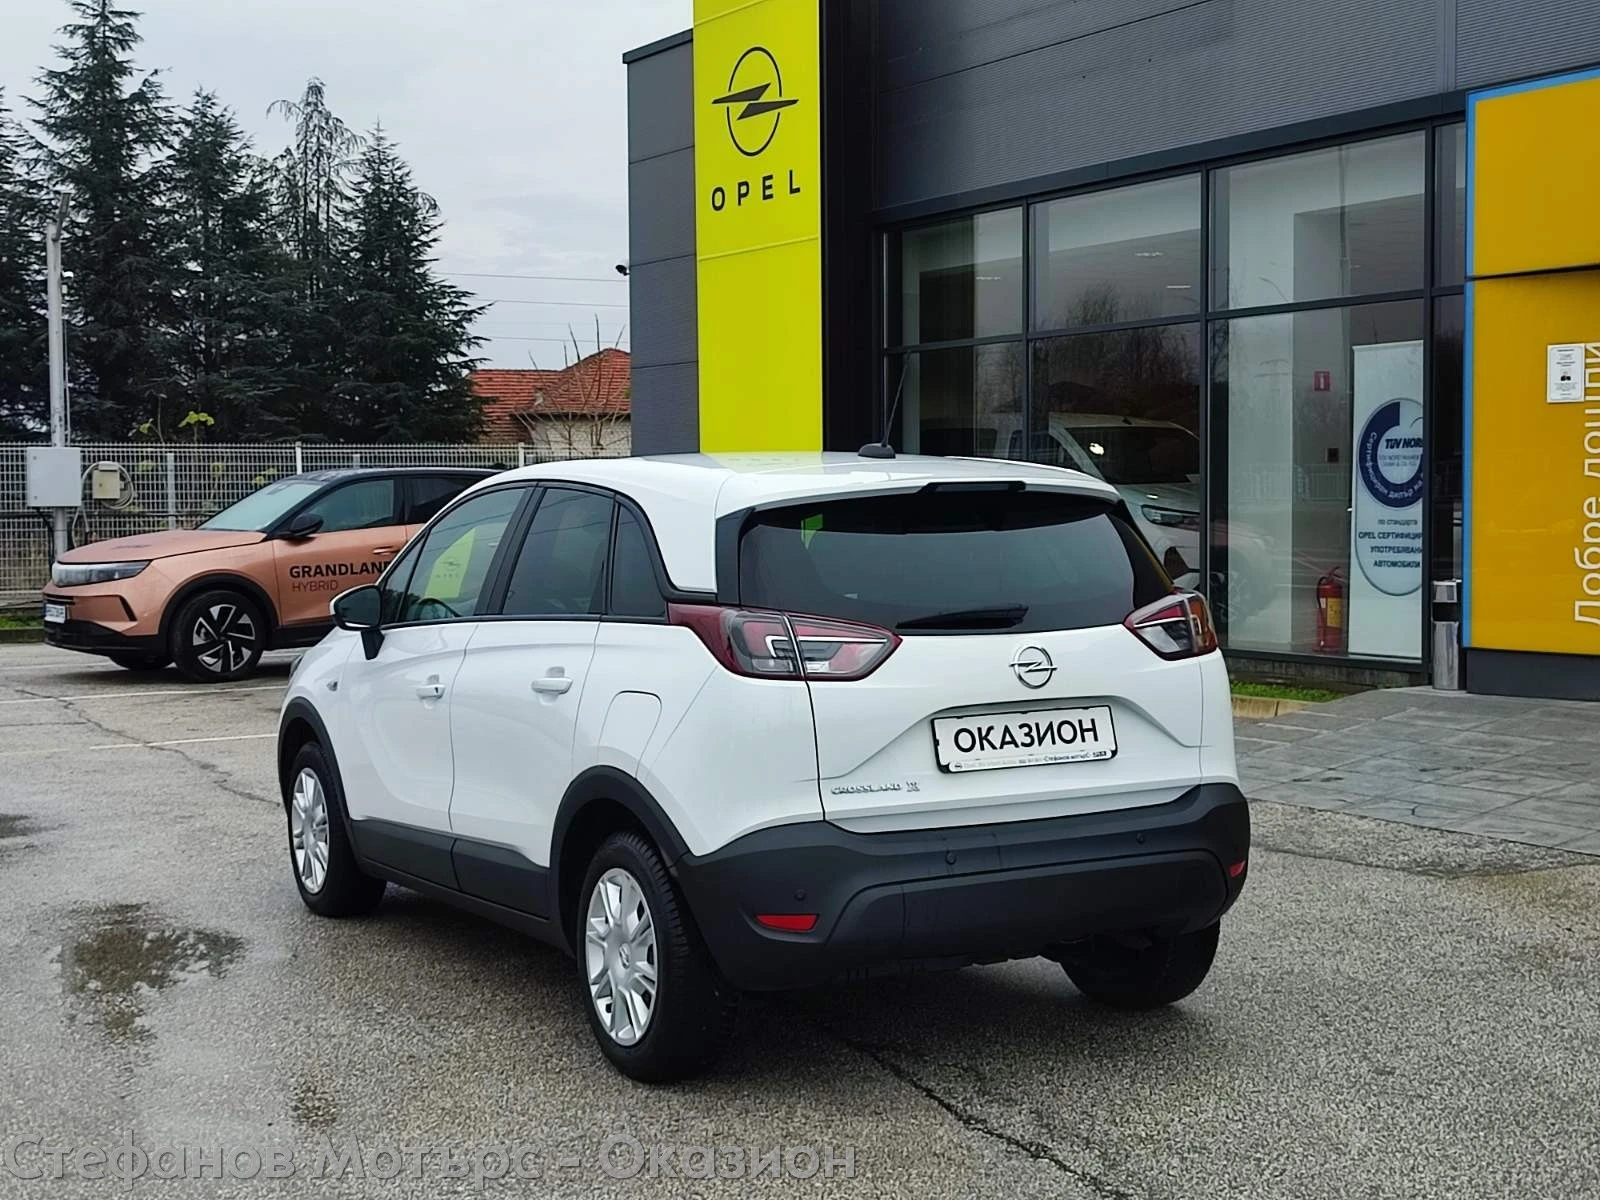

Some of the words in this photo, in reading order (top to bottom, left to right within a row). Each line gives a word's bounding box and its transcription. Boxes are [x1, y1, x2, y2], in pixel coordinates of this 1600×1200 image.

[711, 169, 800, 212] OPEL
[1574, 496, 1600, 625] Добре
[292, 580, 338, 592] HYBRID
[953, 718, 1099, 754] ОКАЗИОН
[831, 783, 902, 795] CROSSLAND
